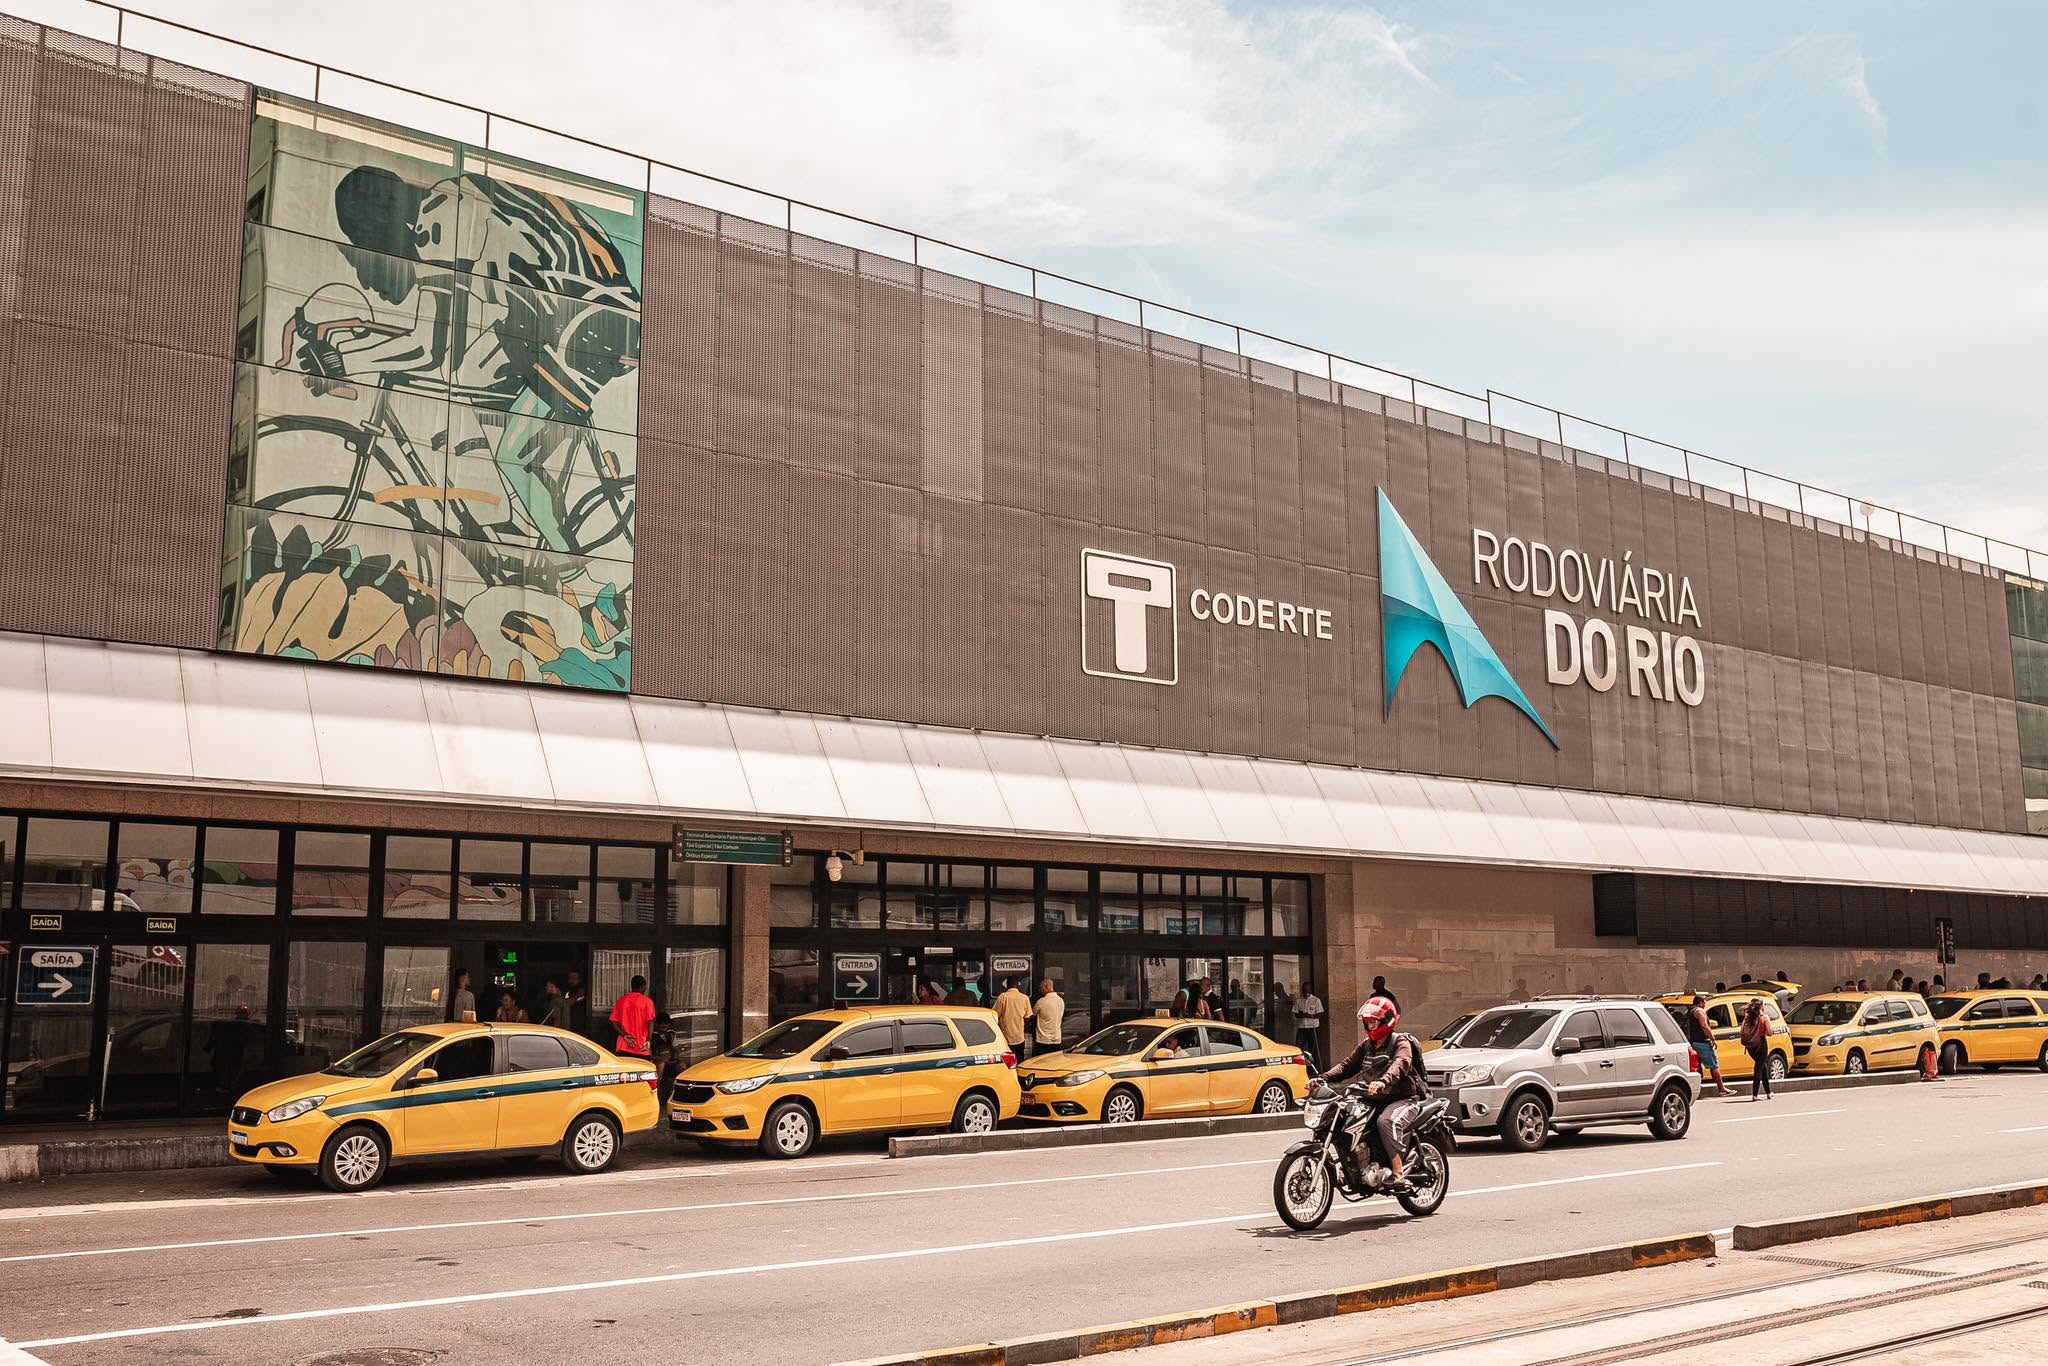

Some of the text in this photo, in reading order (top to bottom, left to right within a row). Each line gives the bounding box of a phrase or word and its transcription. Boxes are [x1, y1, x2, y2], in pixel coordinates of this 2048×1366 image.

[1471, 528, 1701, 628] RODOVIÁRIA
[1190, 589, 1333, 641] CODERTE
[1544, 610, 1705, 707] DO RIO
[32, 918, 59, 927] SAÍDA
[149, 920, 174, 929] SAÍDA
[40, 953, 74, 965] SAÍDA
[841, 961, 874, 970] ENTRADA
[997, 961, 1026, 970] ENTRADA
